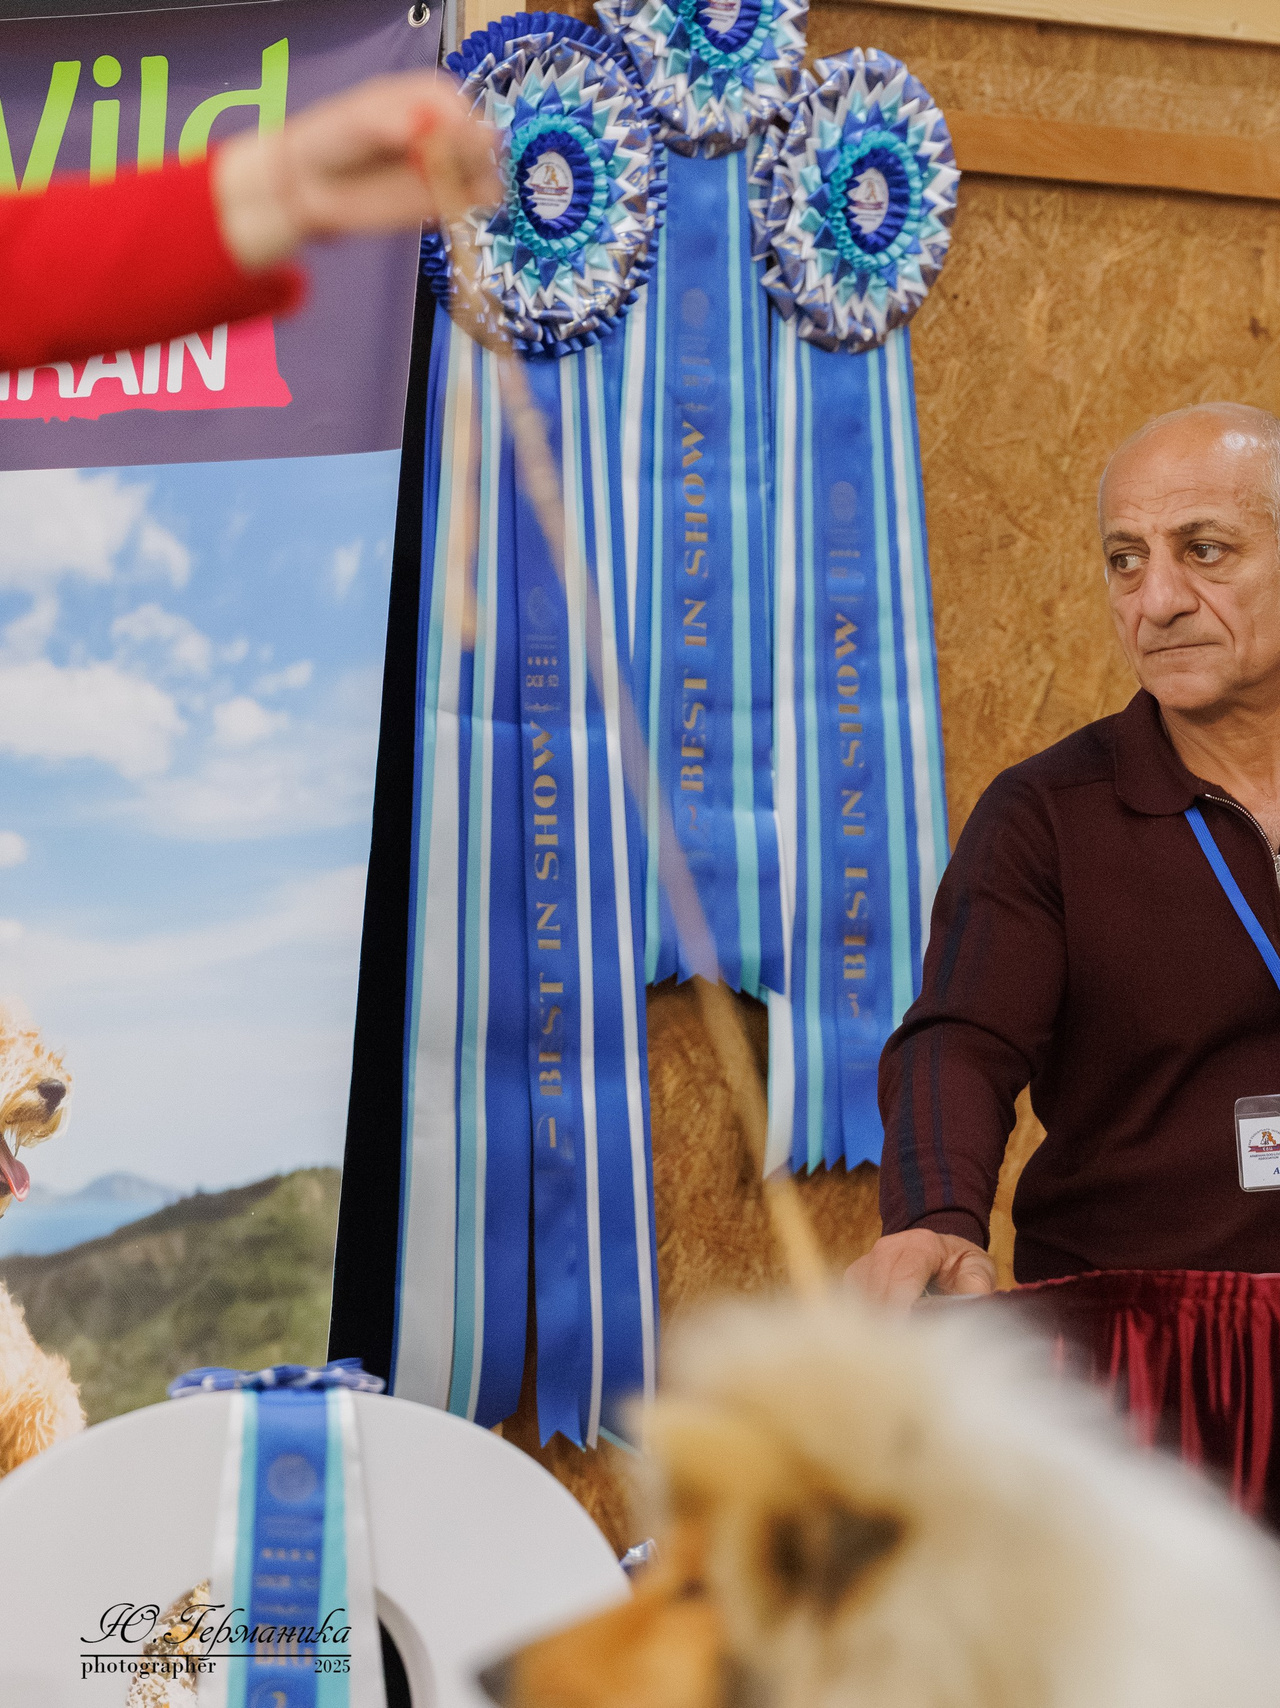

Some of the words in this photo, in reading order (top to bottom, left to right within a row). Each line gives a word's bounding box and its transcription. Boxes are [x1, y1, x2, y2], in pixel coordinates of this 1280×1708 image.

[681, 419, 709, 578] SHOW
[683, 598, 708, 647] IN
[680, 666, 708, 791] BEST
[834, 612, 864, 768] SHOW
[530, 721, 560, 881] SHOW
[841, 789, 866, 836] IN
[535, 902, 562, 950] IN
[538, 972, 564, 1096] BEST
